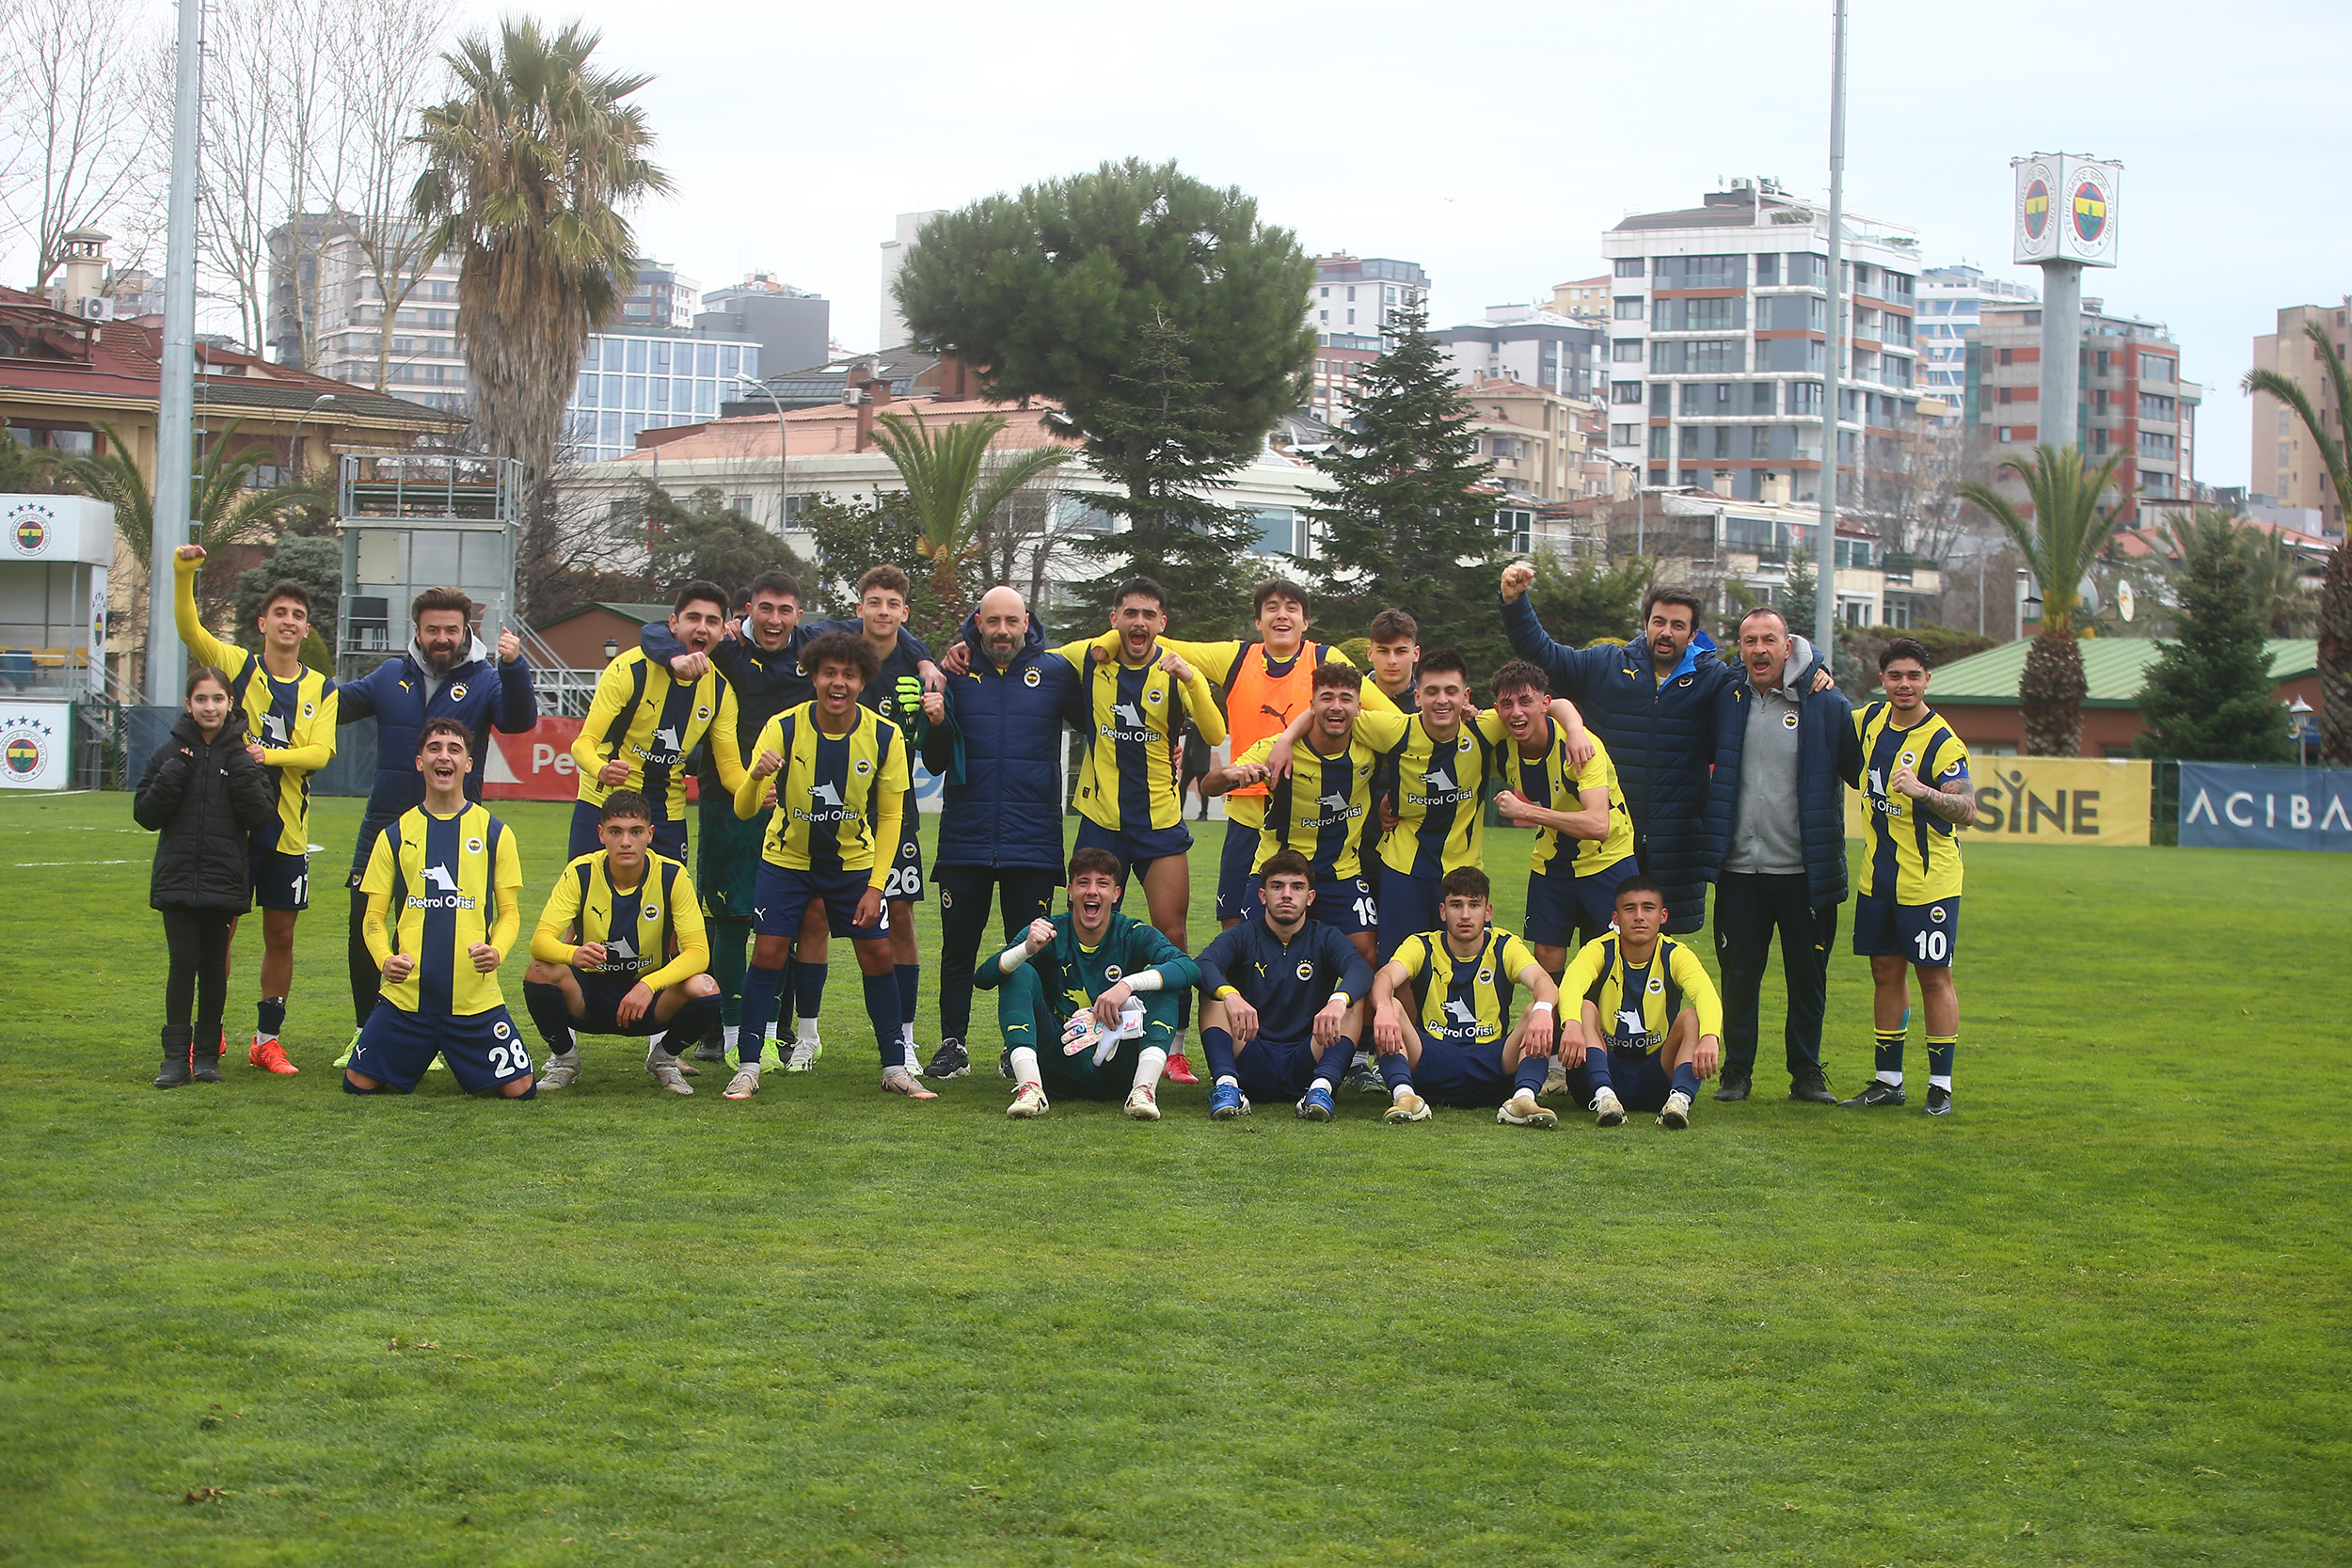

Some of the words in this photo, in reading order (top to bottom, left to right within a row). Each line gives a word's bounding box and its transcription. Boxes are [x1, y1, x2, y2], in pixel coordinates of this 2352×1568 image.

[1101, 723, 1132, 740] Petrol
[1135, 731, 1160, 742] Ofisi
[532, 743, 580, 775] Pe
[631, 744, 666, 764] Petrol
[1408, 793, 1443, 805] Petrol
[1446, 788, 1472, 802] Ofisi
[794, 808, 828, 822] Petrol
[831, 809, 859, 821] Ofisi
[1302, 816, 1336, 827] Petrol
[1338, 803, 1362, 821] Ofisi
[1877, 800, 1901, 816] Ofisi
[2185, 787, 2352, 832] ACIBA
[884, 865, 921, 897] 26
[408, 895, 443, 909] Petrol
[445, 895, 475, 910] Ofisi
[1352, 896, 1378, 927] 19
[1914, 929, 1947, 961] 10
[596, 961, 624, 972] etrol
[627, 955, 653, 970] Ofisi
[1428, 1020, 1463, 1038] Petrol
[1465, 1023, 1494, 1037] Ofisi
[1635, 1031, 1661, 1048] Ofisi
[488, 1038, 529, 1079] 28
